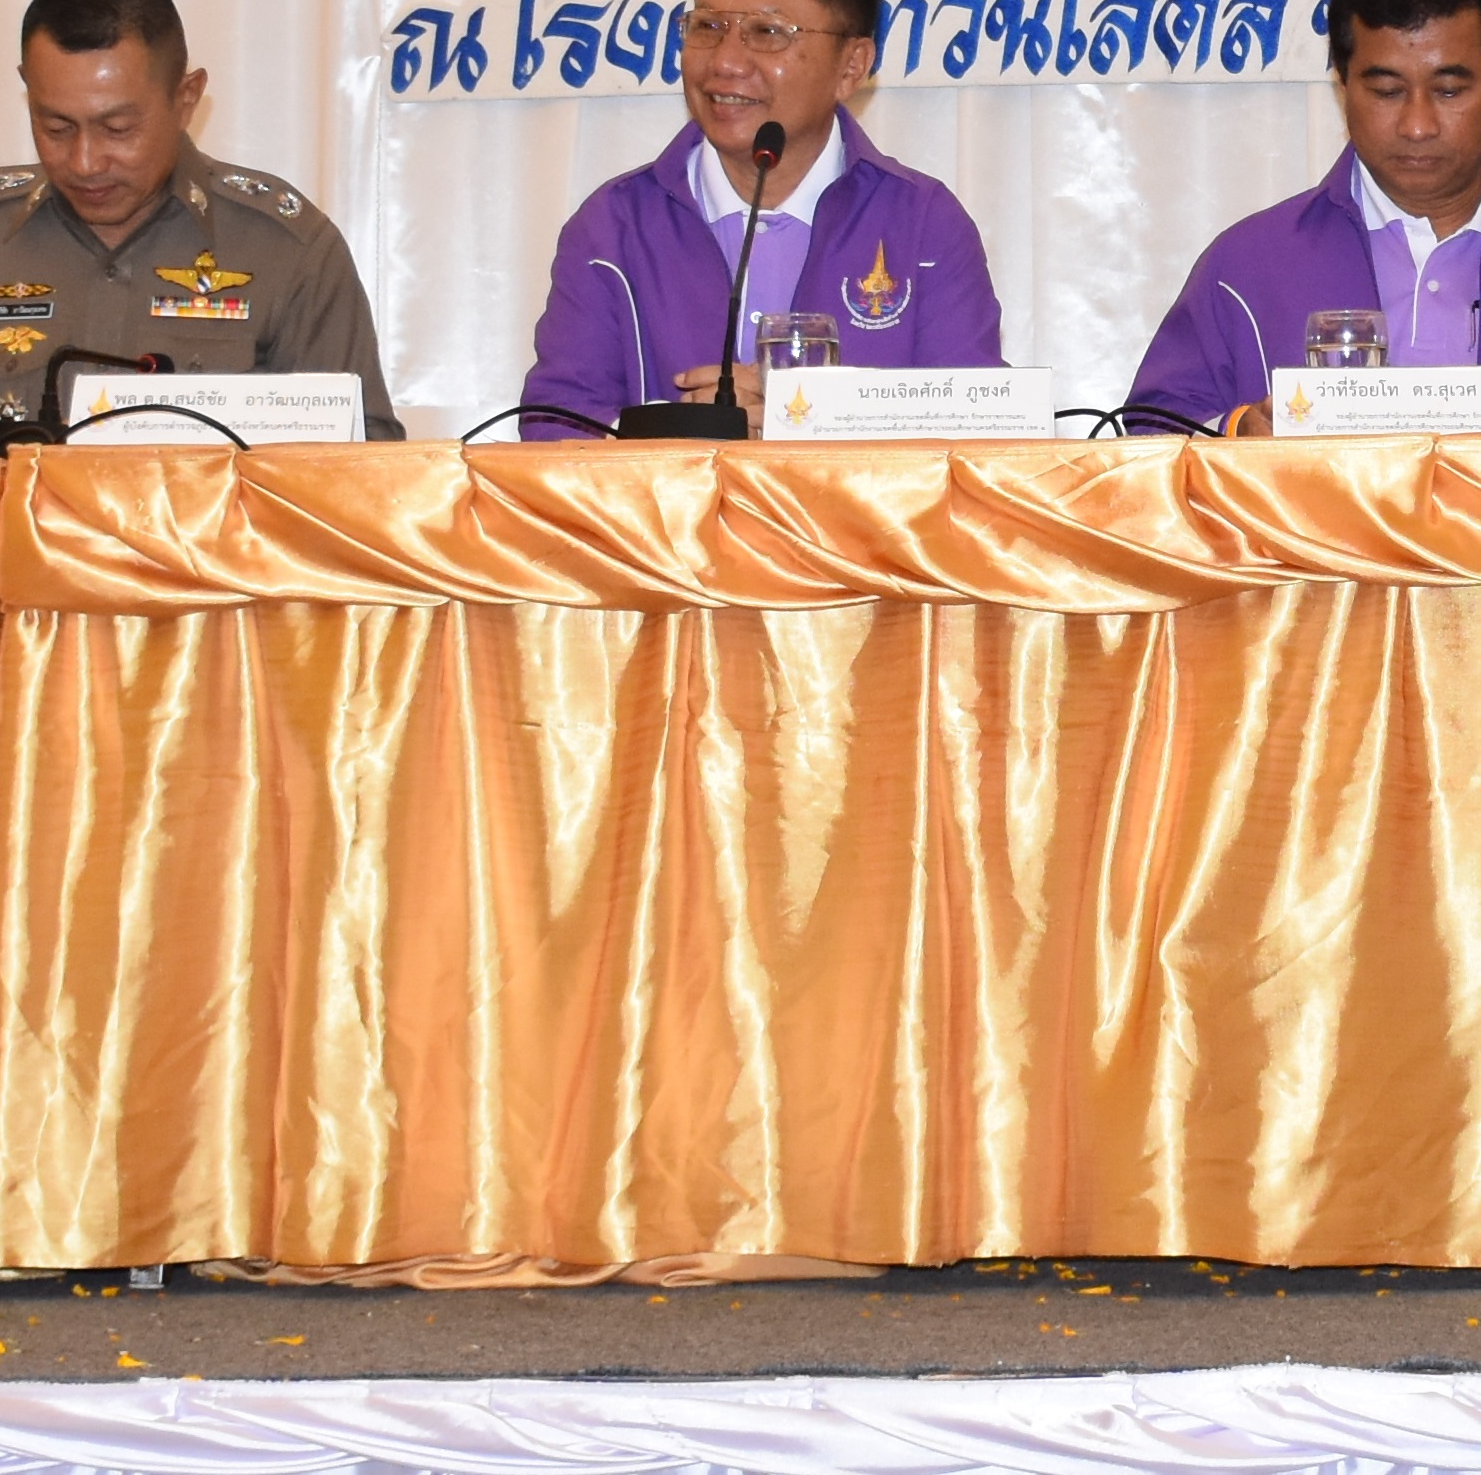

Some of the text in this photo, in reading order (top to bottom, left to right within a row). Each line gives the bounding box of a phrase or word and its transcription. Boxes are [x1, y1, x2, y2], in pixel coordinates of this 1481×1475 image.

[245, 390, 352, 411] อาวัฒนกุลเทพ
[857, 377, 1011, 403] นายเจิดศักดิ์ ภูชงค์
[1316, 376, 1399, 398] ว่าที่ร้อยโท
[1412, 382, 1477, 402] ดร.สุเวศ
